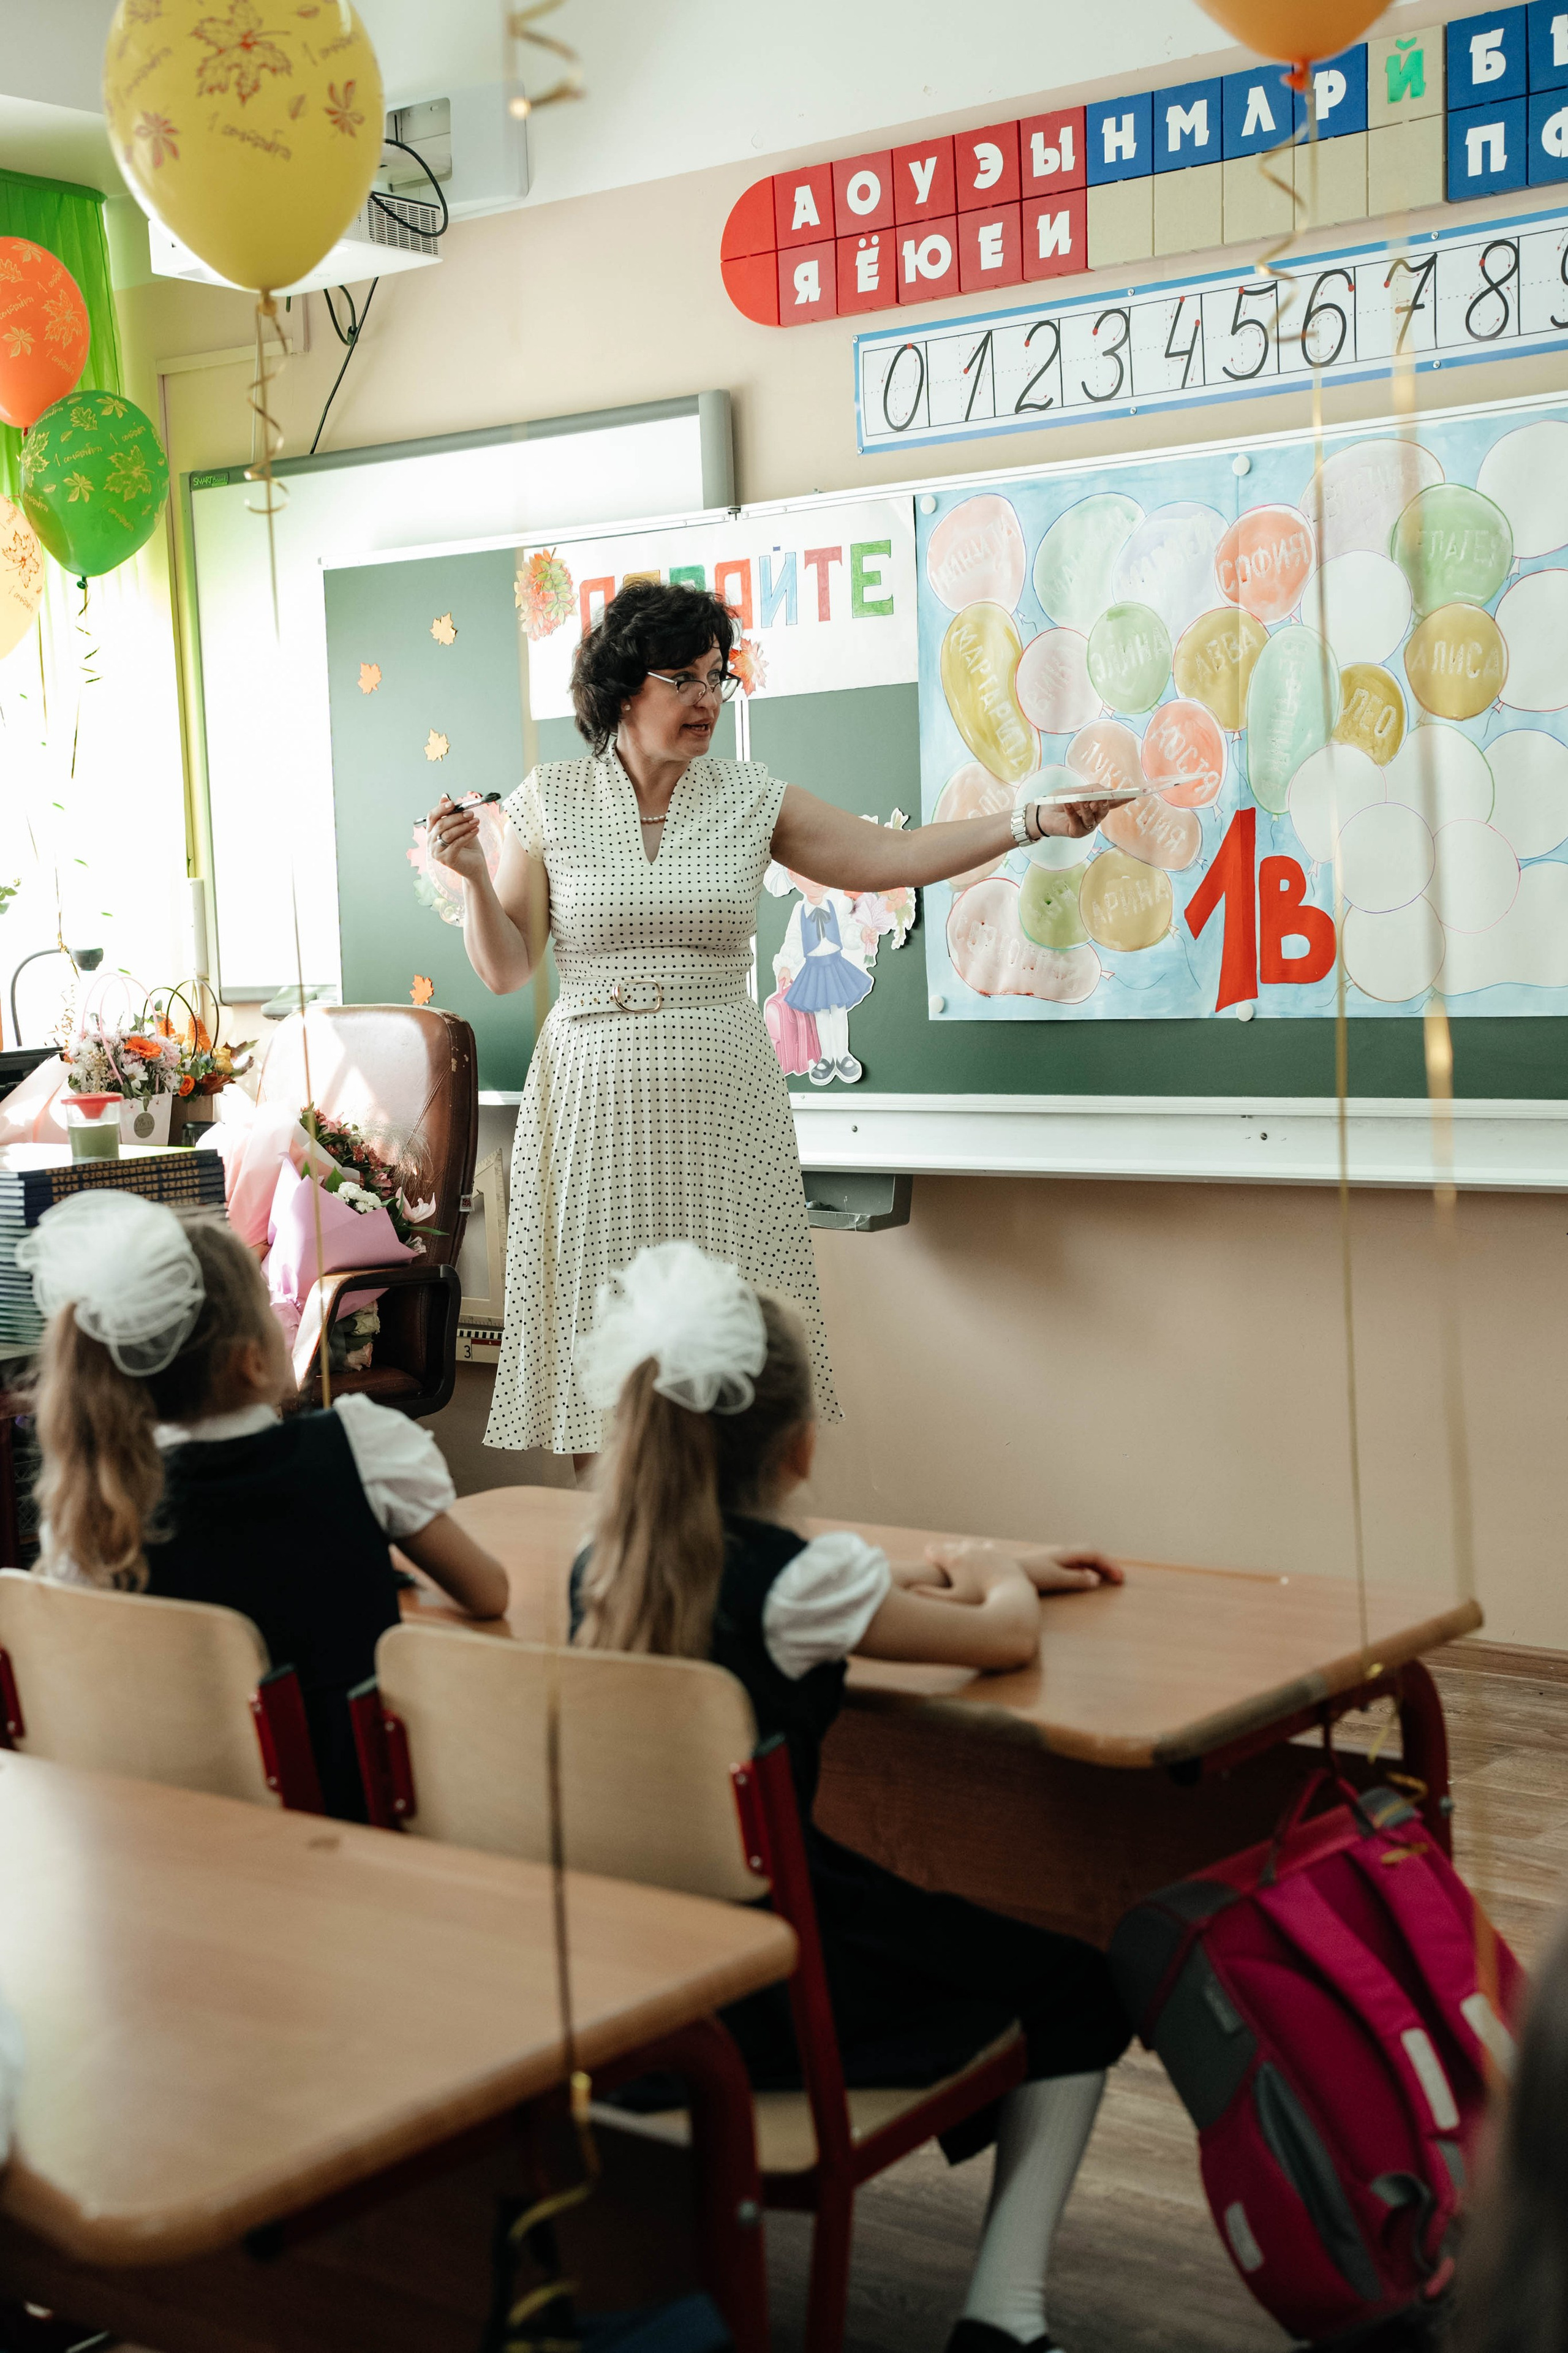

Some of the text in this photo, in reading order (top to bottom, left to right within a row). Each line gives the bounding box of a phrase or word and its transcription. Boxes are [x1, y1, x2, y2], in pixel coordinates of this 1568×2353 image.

[791, 185, 820, 230] А
[847, 171, 881, 216] О
[908, 156, 937, 205] У
[973, 142, 1003, 189] Э
[1030, 126, 1076, 178] Ы
[1101, 113, 1137, 164] Н
[1166, 99, 1209, 152] М
[1242, 86, 1276, 137] Л
[1313, 70, 1346, 120] Р
[1385, 37, 1427, 104] Й
[1469, 28, 1506, 85] Б
[793, 260, 821, 305] Я
[856, 235, 880, 293] Ё
[902, 234, 952, 284] Ю
[978, 222, 1003, 270] Е
[1037, 210, 1072, 259] И
[1465, 122, 1507, 176] П
[883, 342, 924, 431] 0
[963, 330, 993, 421] 1
[1014, 320, 1060, 414] 2
[1082, 308, 1130, 401] 3
[1165, 296, 1200, 388] 4
[1223, 282, 1278, 380] 5
[1302, 268, 1355, 367] 6
[1384, 252, 1437, 355] 7
[1466, 240, 1518, 341] 8
[194, 476, 213, 486] SMART
[1218, 532, 1311, 593] СОФИЯ
[1411, 640, 1500, 678] АЛИСА
[464, 1345, 470, 1358] 3
